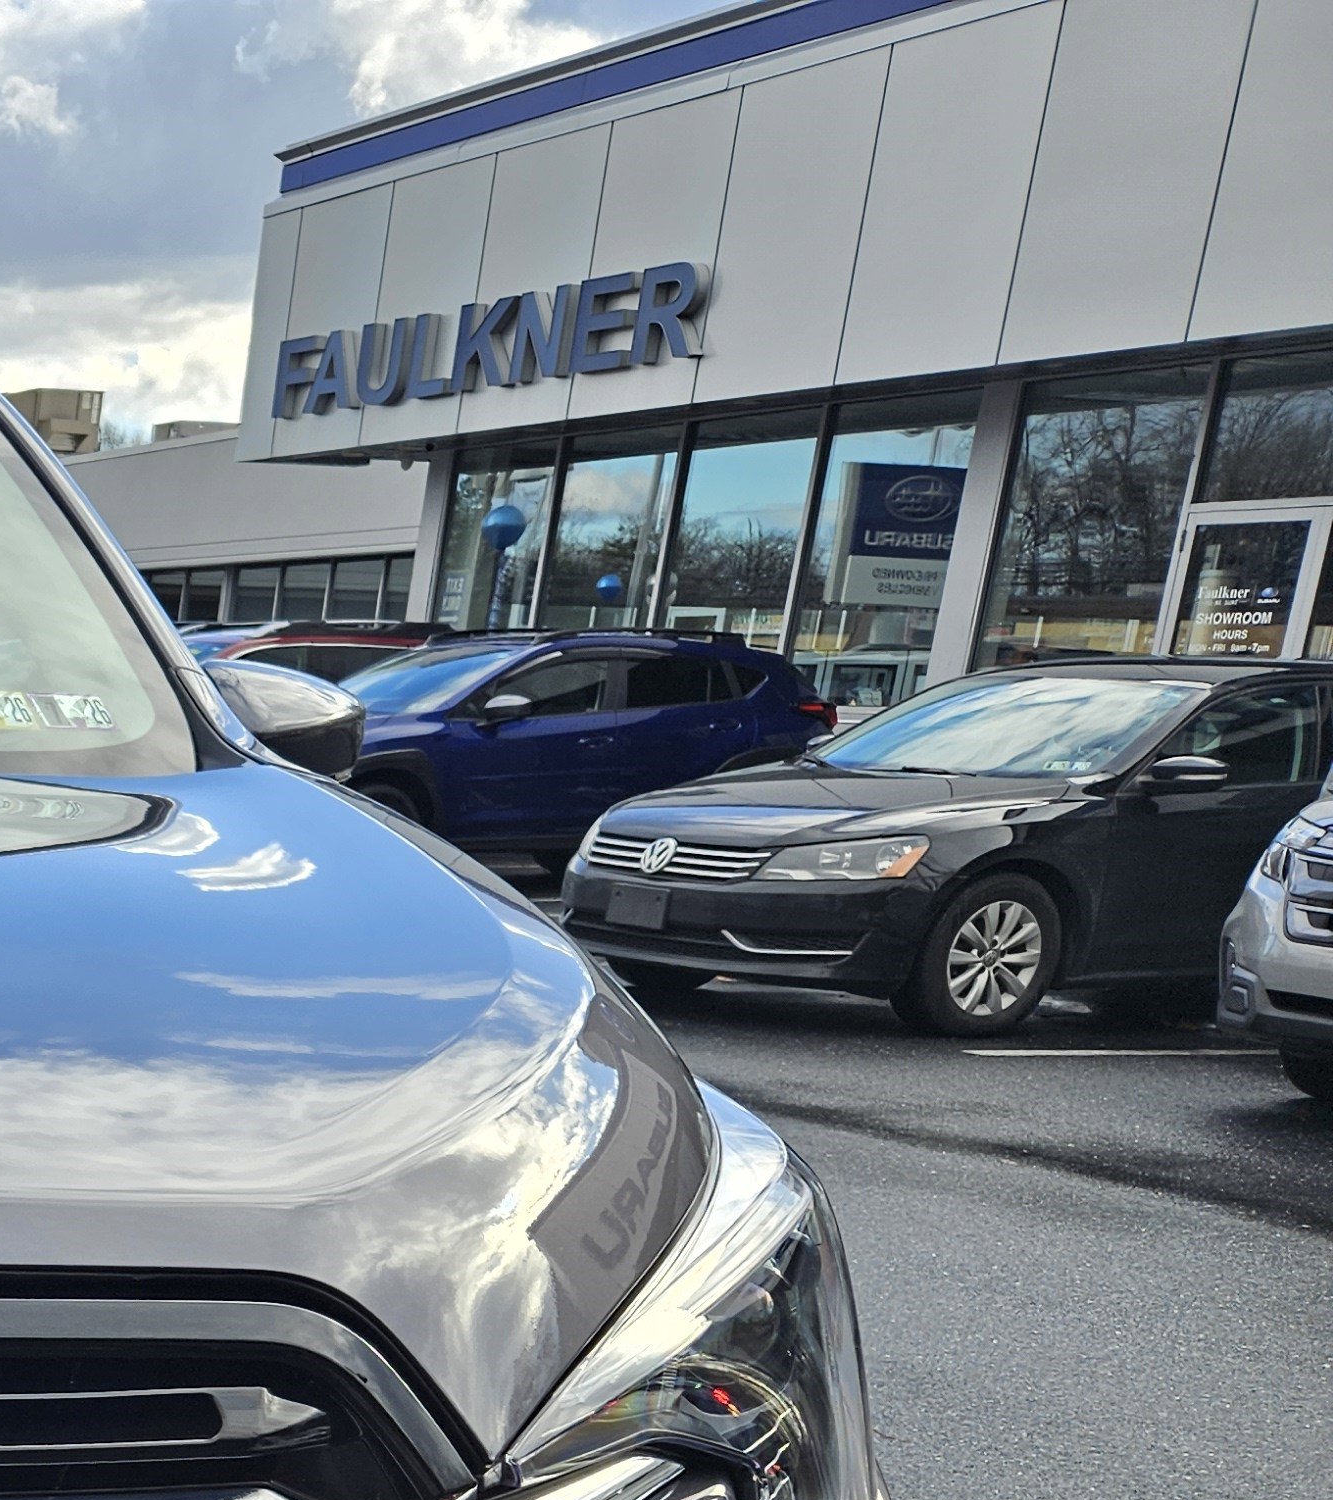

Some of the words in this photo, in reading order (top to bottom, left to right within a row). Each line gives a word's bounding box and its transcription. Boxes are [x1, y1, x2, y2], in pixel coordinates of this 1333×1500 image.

[271, 261, 710, 420] FAULKNER
[1198, 586, 1250, 599] Faulkner
[1196, 611, 1273, 625] SHOWROOM
[1213, 629, 1249, 640] HOURS
[4, 696, 32, 723] 26
[83, 698, 112, 725] 26
